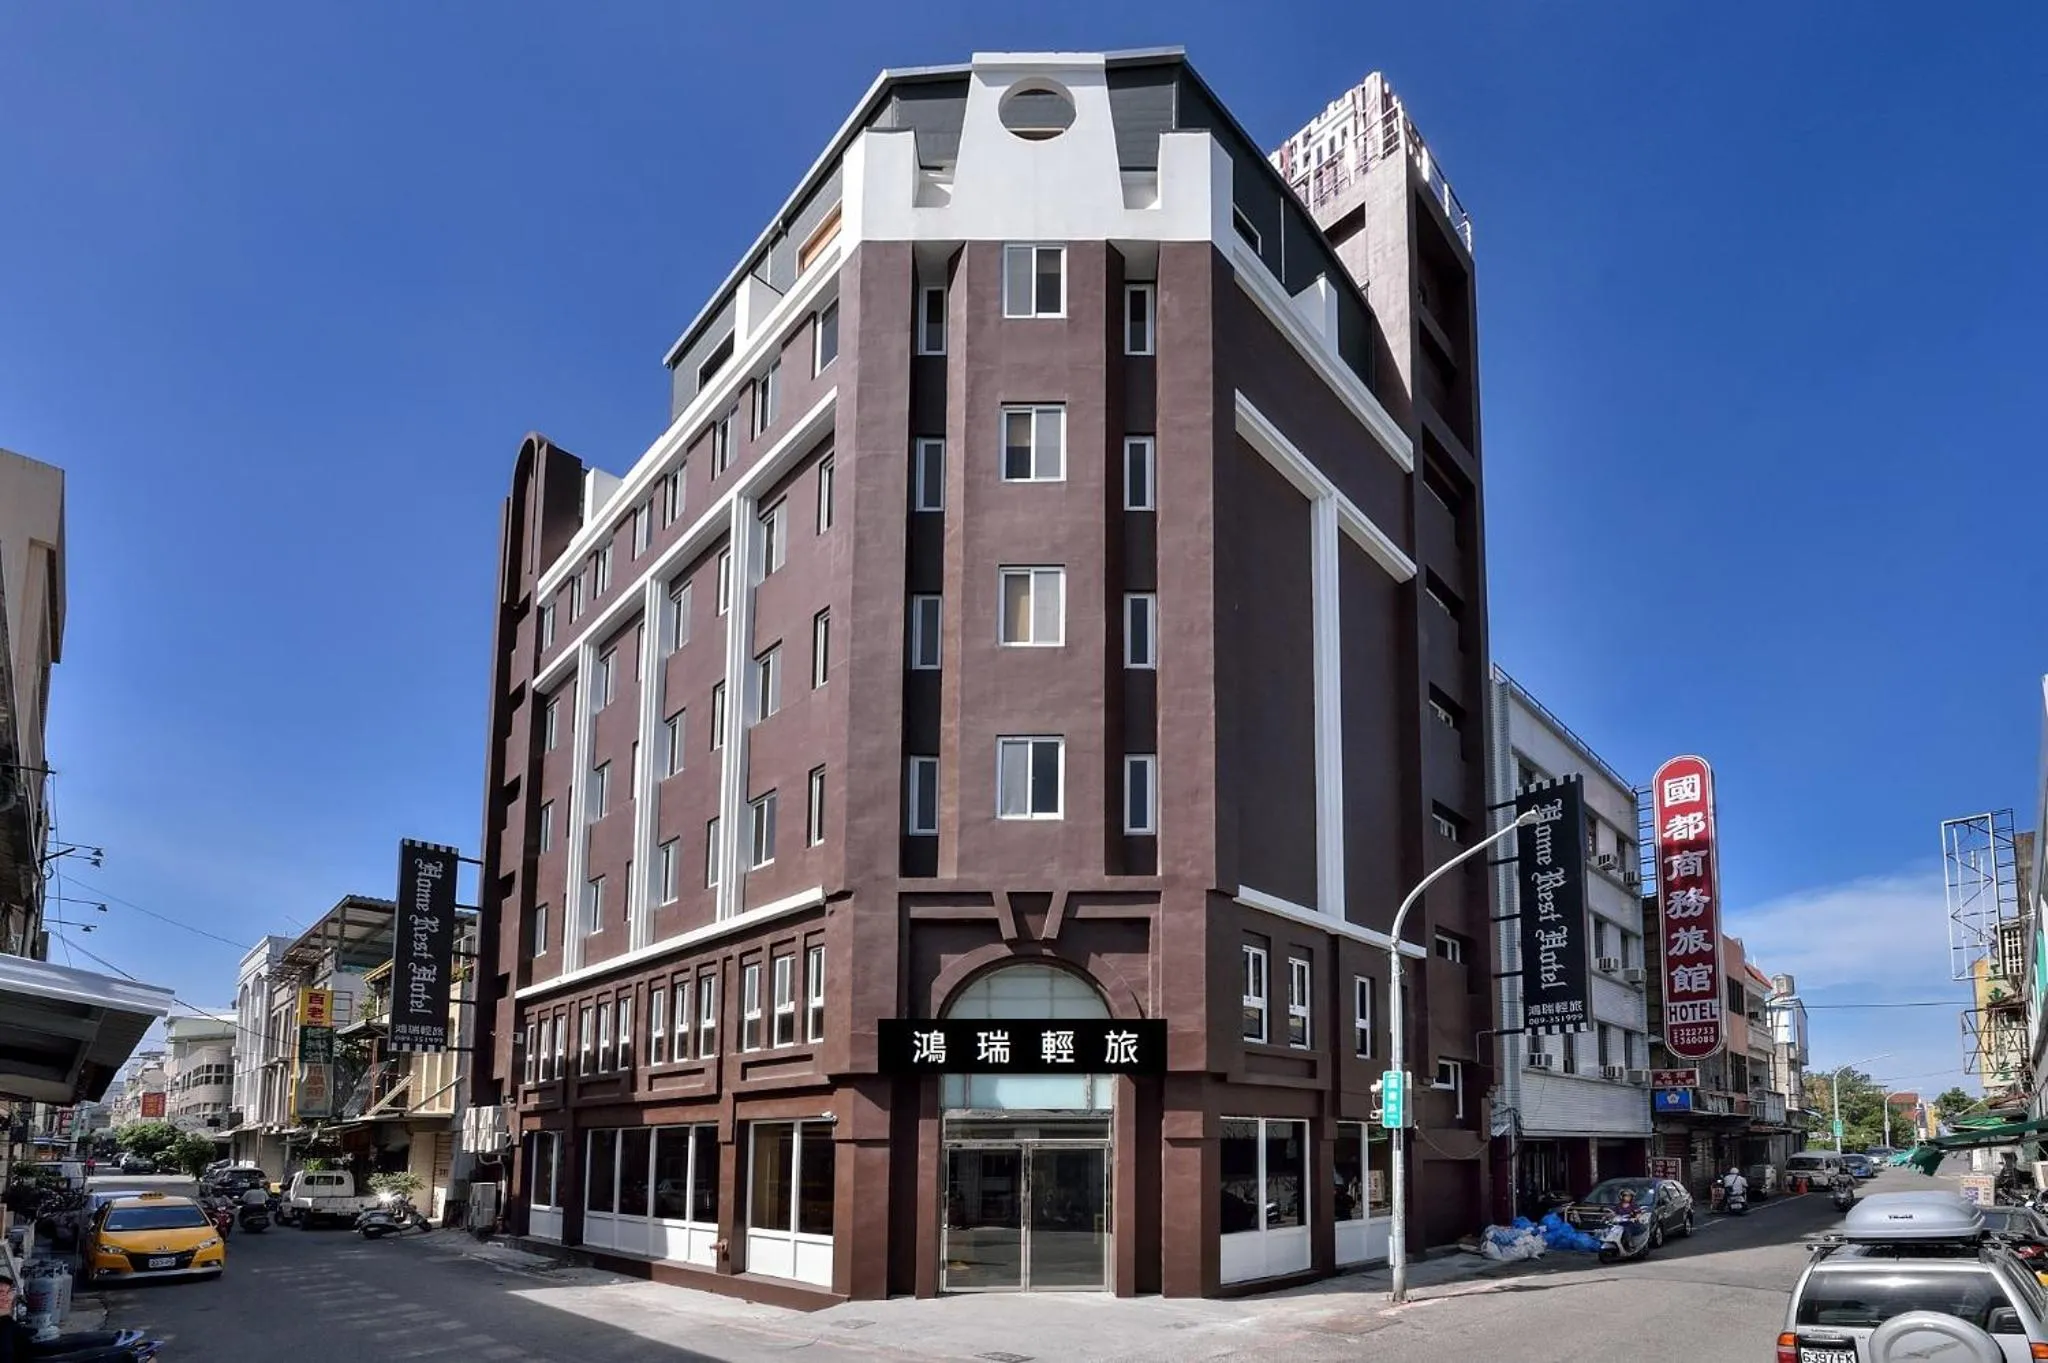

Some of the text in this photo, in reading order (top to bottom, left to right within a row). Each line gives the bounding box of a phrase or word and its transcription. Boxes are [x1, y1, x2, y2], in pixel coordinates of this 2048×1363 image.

[1532, 798, 1568, 990] Home Rest Hotel
[1663, 773, 1713, 993] 國都商務旅館
[408, 858, 443, 1015] Home Rest Hotel
[912, 1030, 1139, 1064] 鴻瑞輕旅
[1528, 1000, 1583, 1016] 鴻瑞輕旅
[1669, 1003, 1717, 1022] HOTEL
